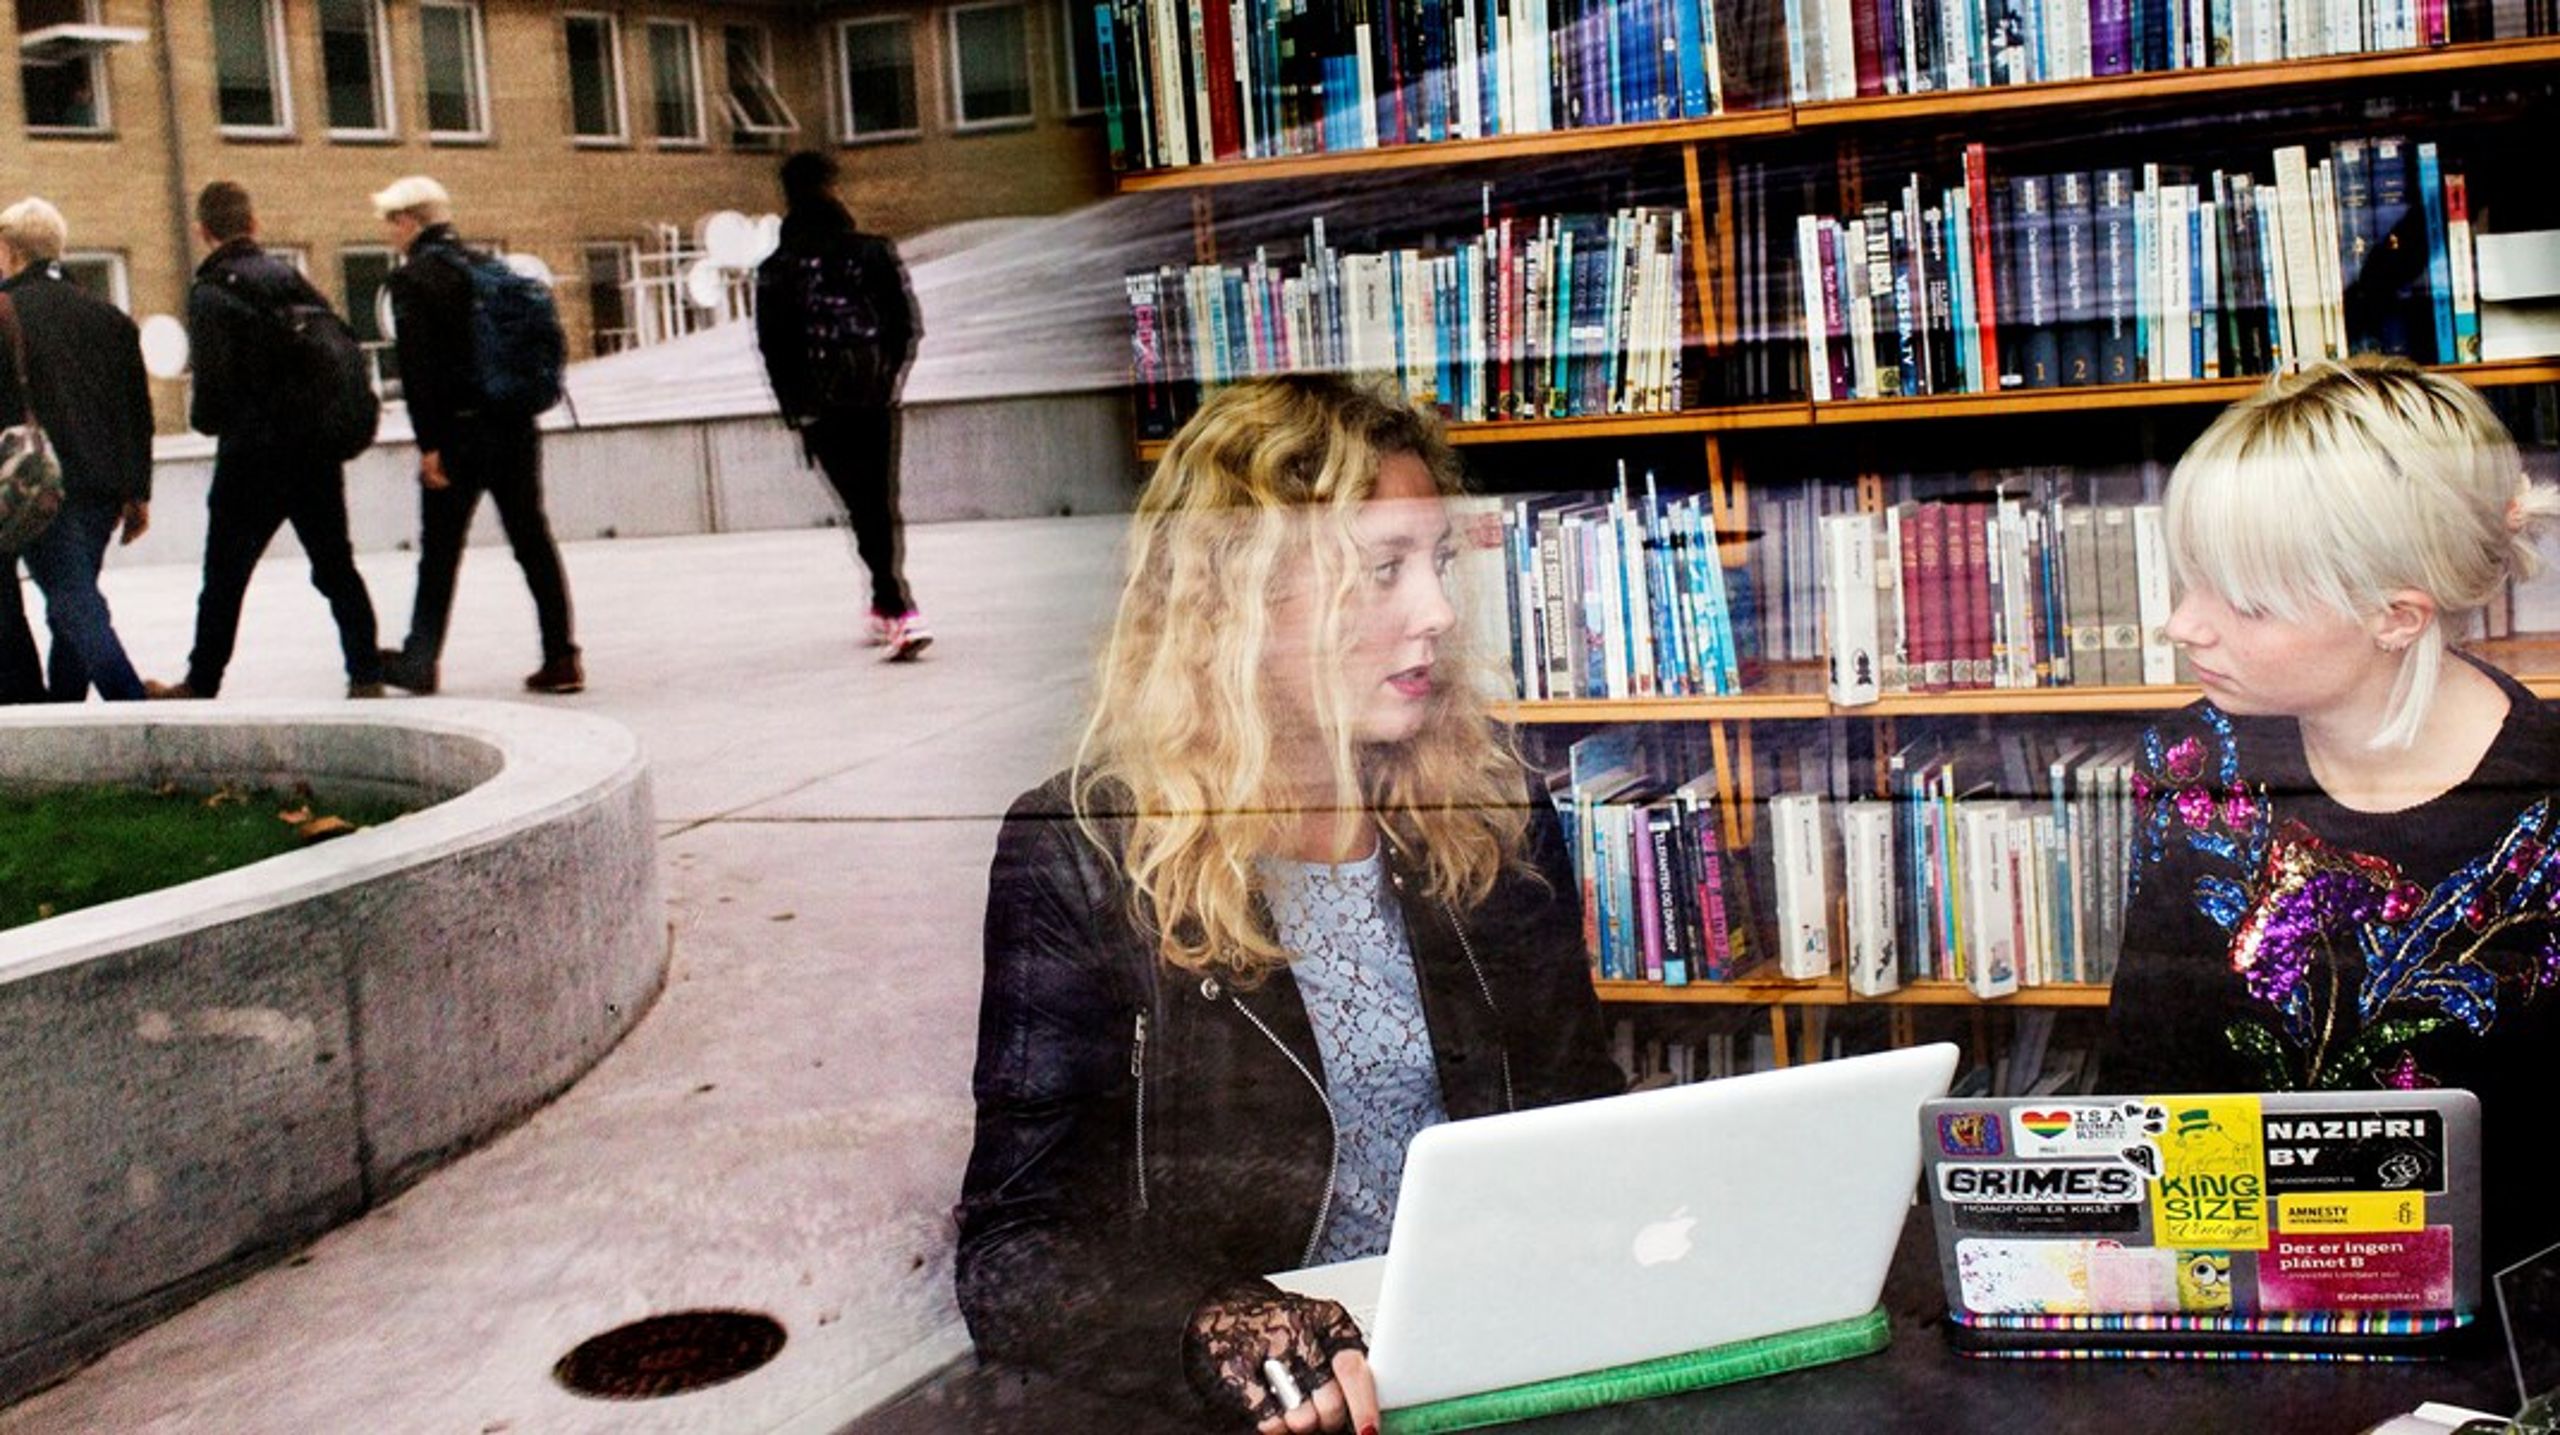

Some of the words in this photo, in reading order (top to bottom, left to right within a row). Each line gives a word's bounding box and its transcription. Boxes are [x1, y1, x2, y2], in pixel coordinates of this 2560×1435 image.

[2035, 362, 2046, 382] 1
[2073, 359, 2087, 380] 2
[2113, 356, 2125, 377] 3
[1661, 891, 1673, 907] OG
[2109, 1109, 2125, 1122] A
[2267, 1119, 2426, 1140] NAZIFRI
[2269, 1148, 2320, 1167] BY
[1947, 1168, 2136, 1198] GRIMES
[2159, 1173, 2261, 1198] KING
[2165, 1198, 2260, 1221] SIZE
[2288, 1207, 2349, 1217] AMNESTY
[2279, 1243, 2315, 1255] Der
[2319, 1244, 2341, 1254] er
[2344, 1242, 2404, 1256] ingen
[2350, 1256, 2365, 1269] B
[2337, 1291, 2420, 1302] Enhedslisten
